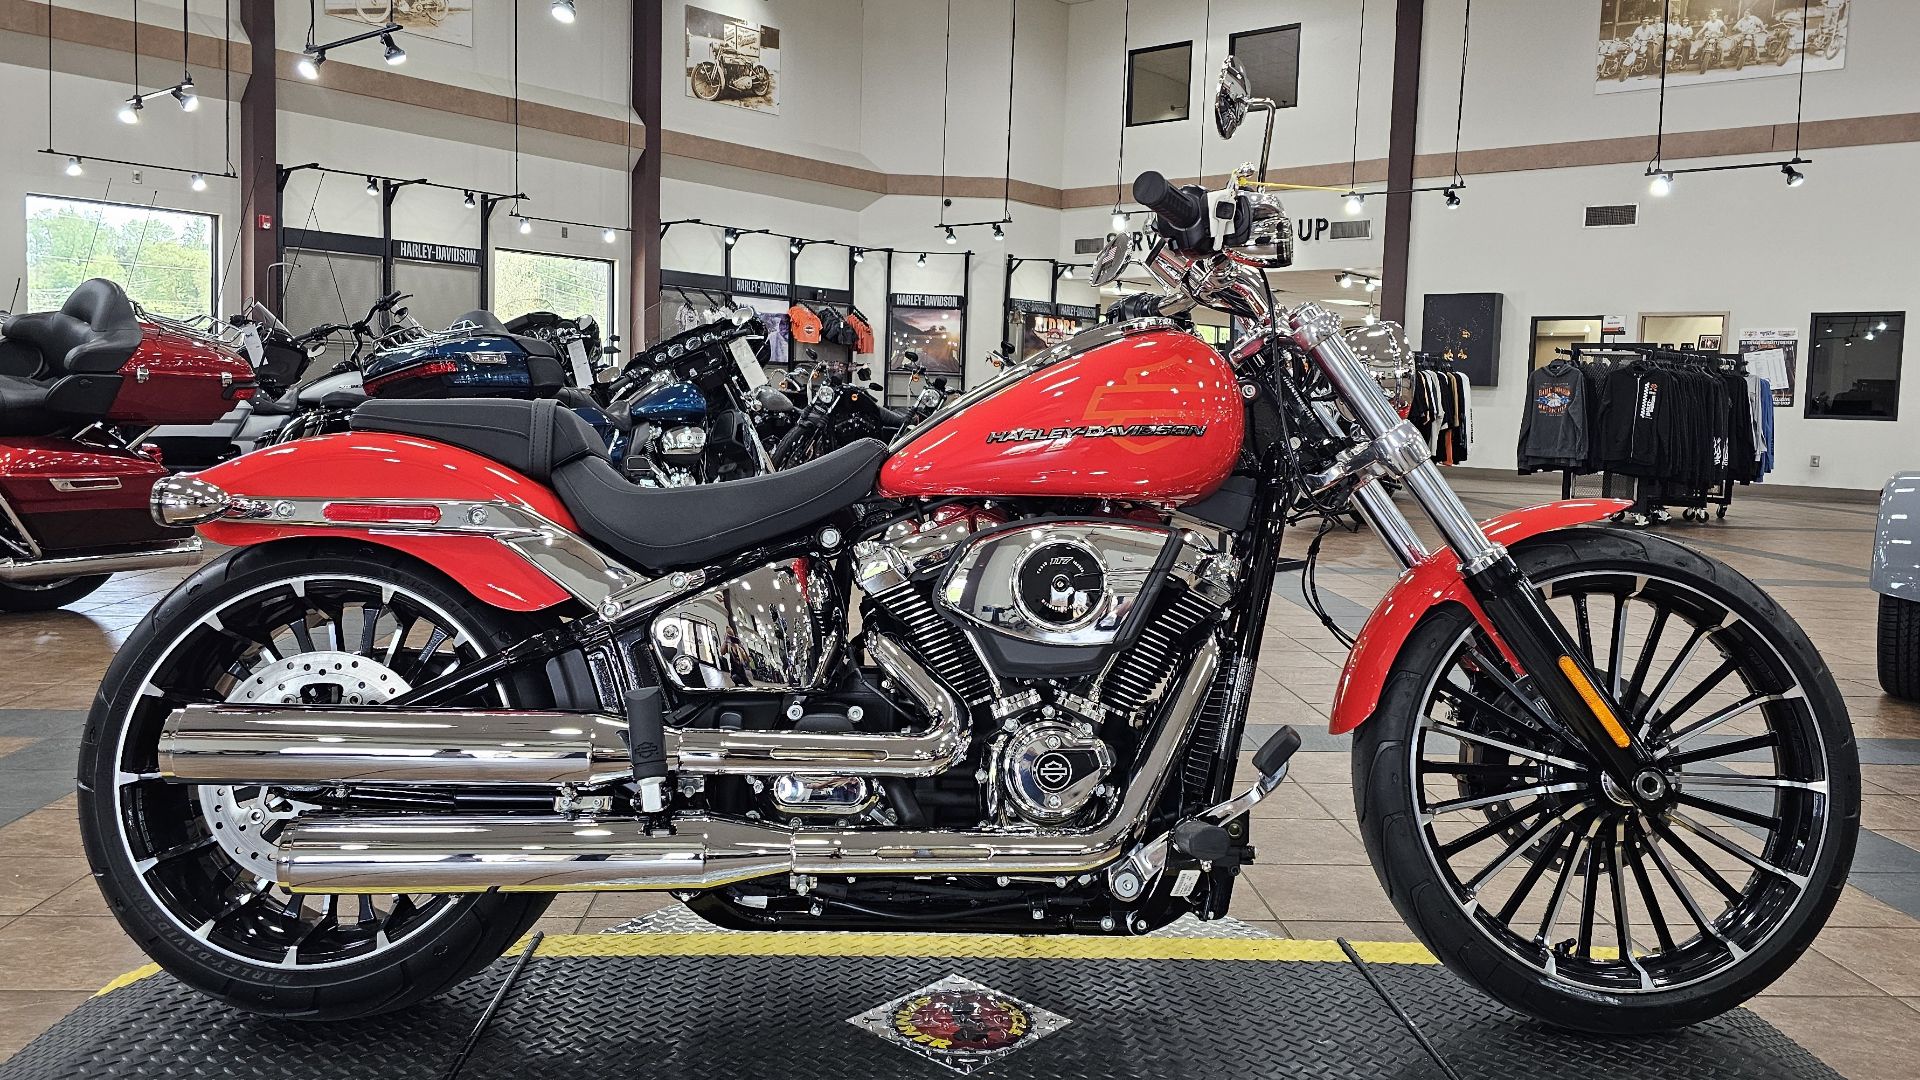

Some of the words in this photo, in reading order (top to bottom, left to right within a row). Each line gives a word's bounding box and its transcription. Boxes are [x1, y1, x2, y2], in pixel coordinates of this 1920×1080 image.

[1298, 219, 1329, 242] UP
[400, 242, 478, 264] HARLEY-DAVIDSON
[736, 280, 788, 296] HARLEY-DAVIDSON
[896, 294, 959, 307] HARLEY-DAVIDSON
[987, 425, 1208, 442] HARLEY-DAVIDSON
[1049, 556, 1074, 565] 117
